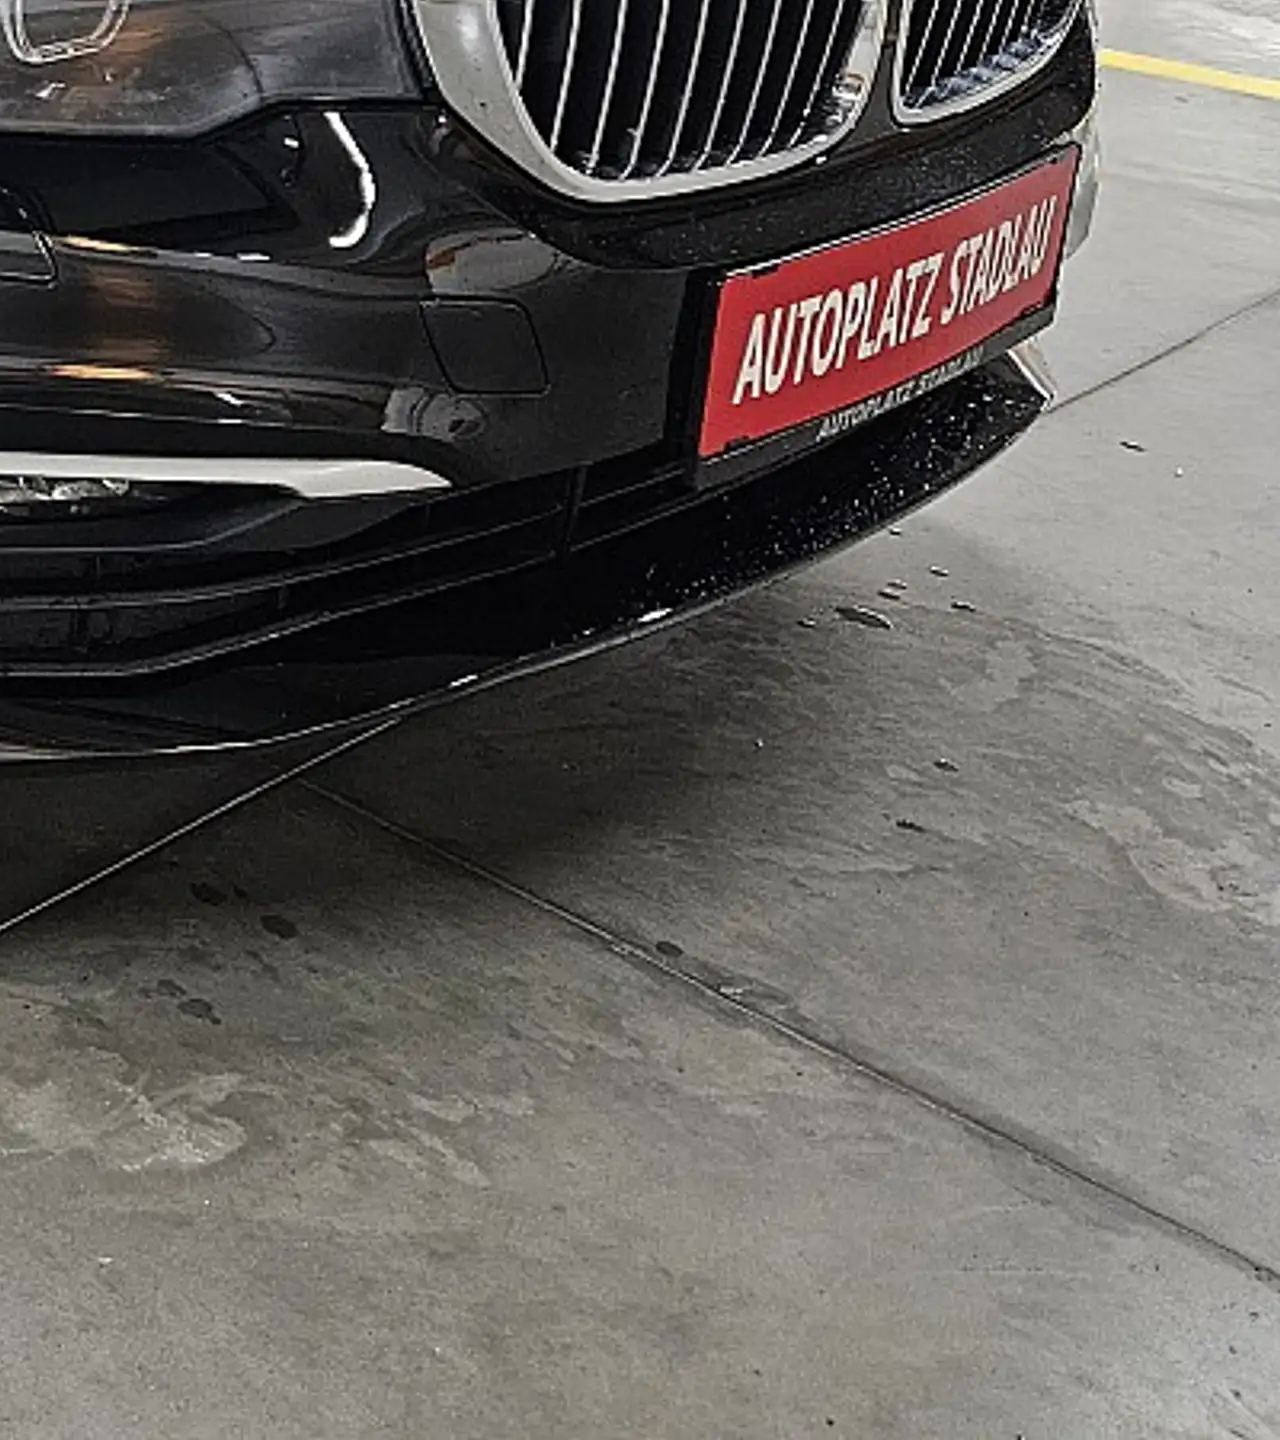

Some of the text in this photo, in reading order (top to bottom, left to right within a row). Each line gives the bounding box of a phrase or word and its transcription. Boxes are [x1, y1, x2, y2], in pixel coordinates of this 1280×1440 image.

[731, 195, 1057, 404] AUTOPLATZ STADLAU
[815, 380, 916, 443] AUTOPLATZ
